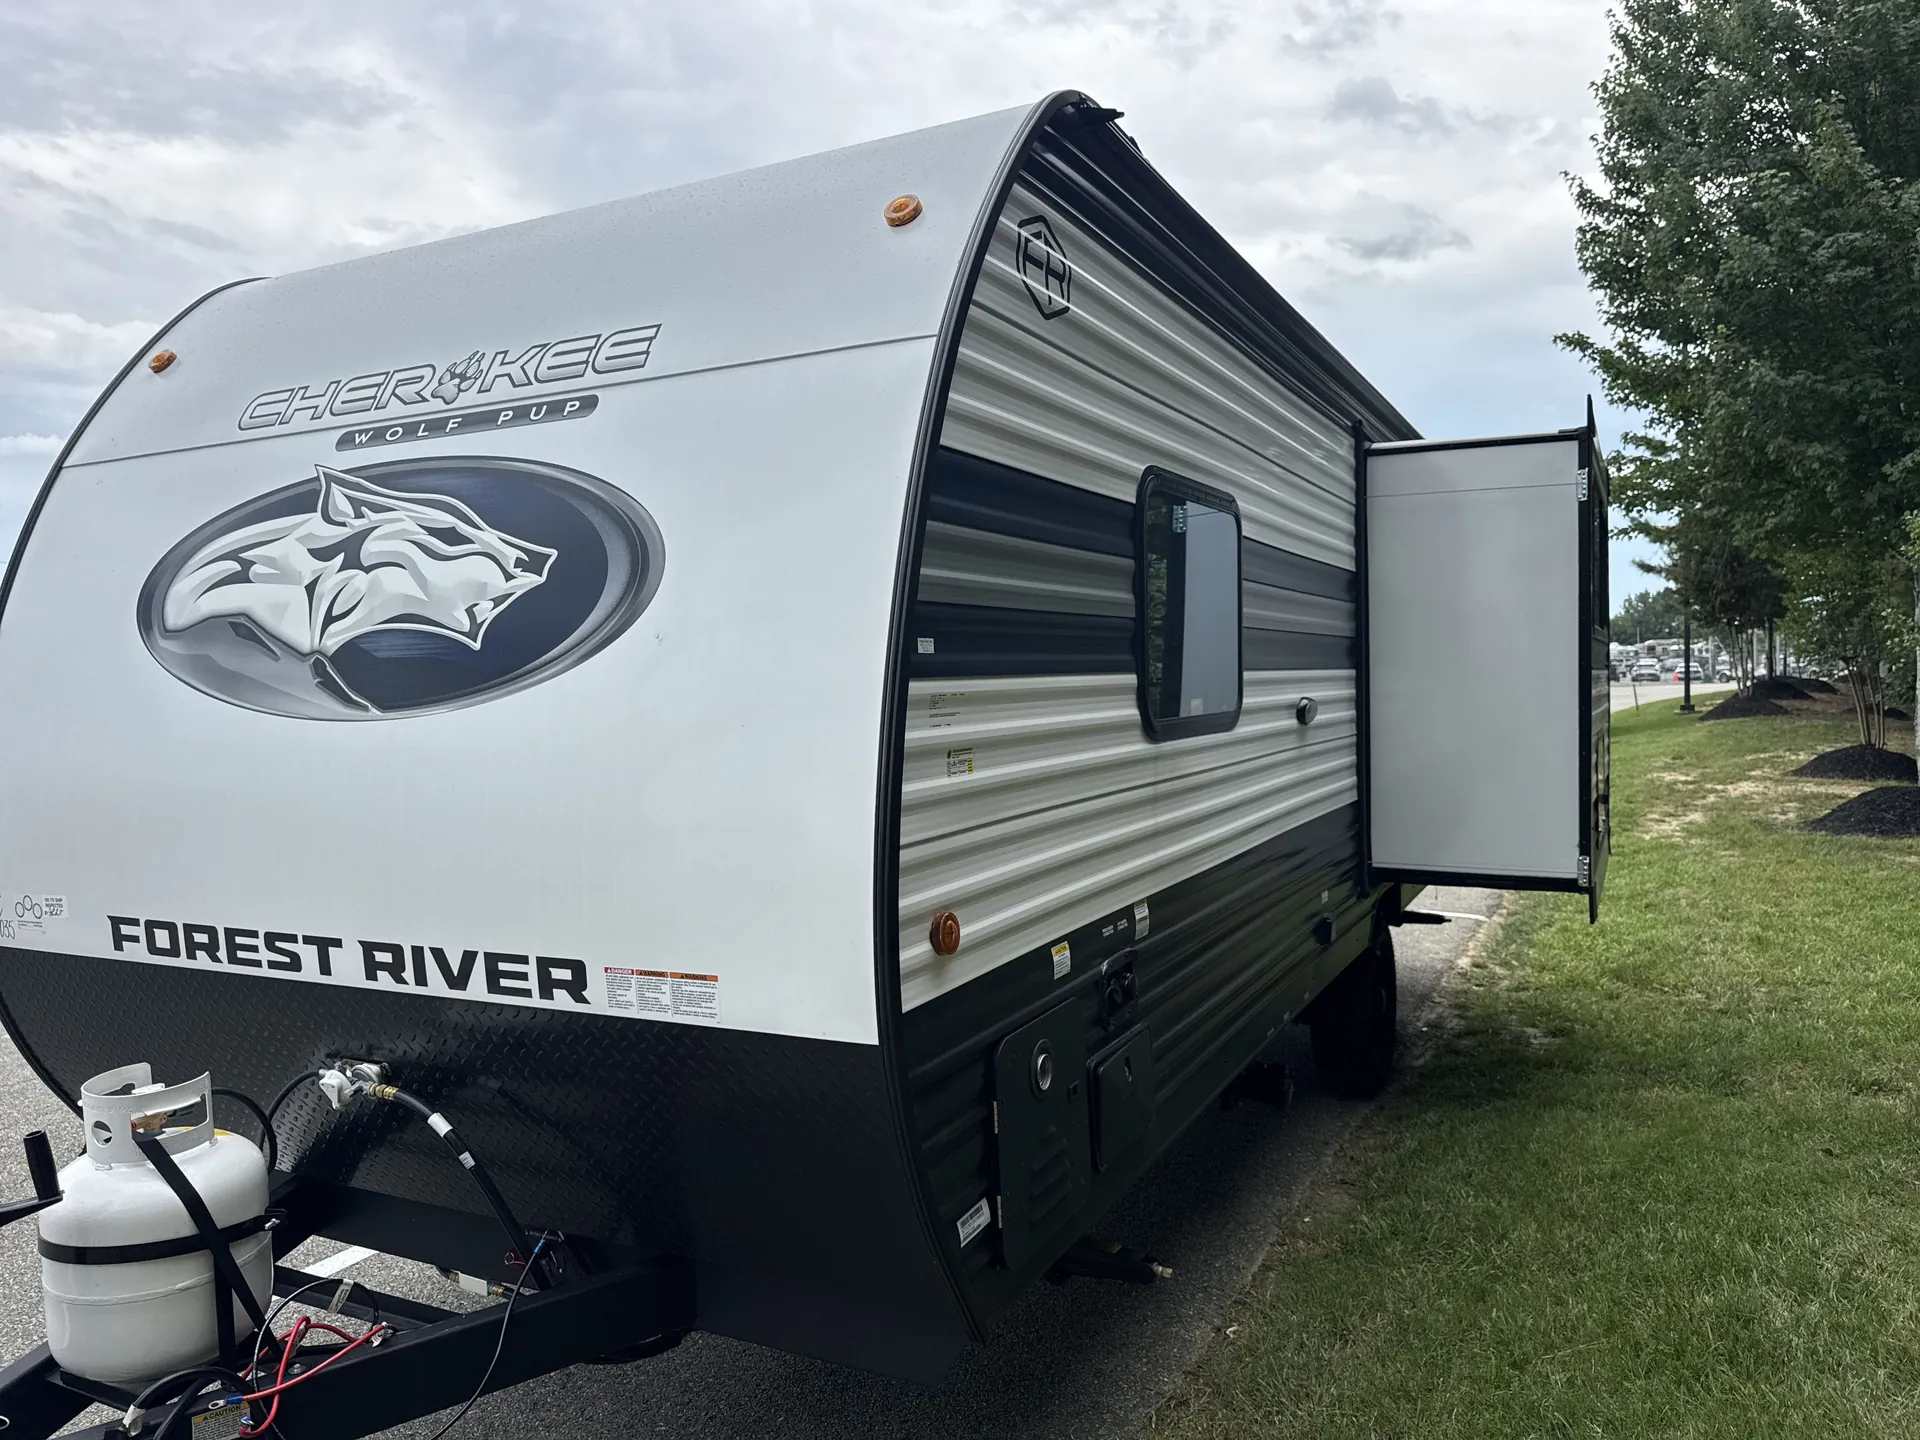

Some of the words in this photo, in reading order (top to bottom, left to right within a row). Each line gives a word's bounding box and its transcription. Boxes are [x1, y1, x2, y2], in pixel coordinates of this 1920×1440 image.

[353, 417, 462, 446] WOLF
[497, 400, 581, 427] PUP
[106, 915, 343, 976] FOREST
[357, 940, 592, 1005] RIVER
[611, 967, 633, 975] DANGER
[209, 1405, 241, 1418] CAUTION
